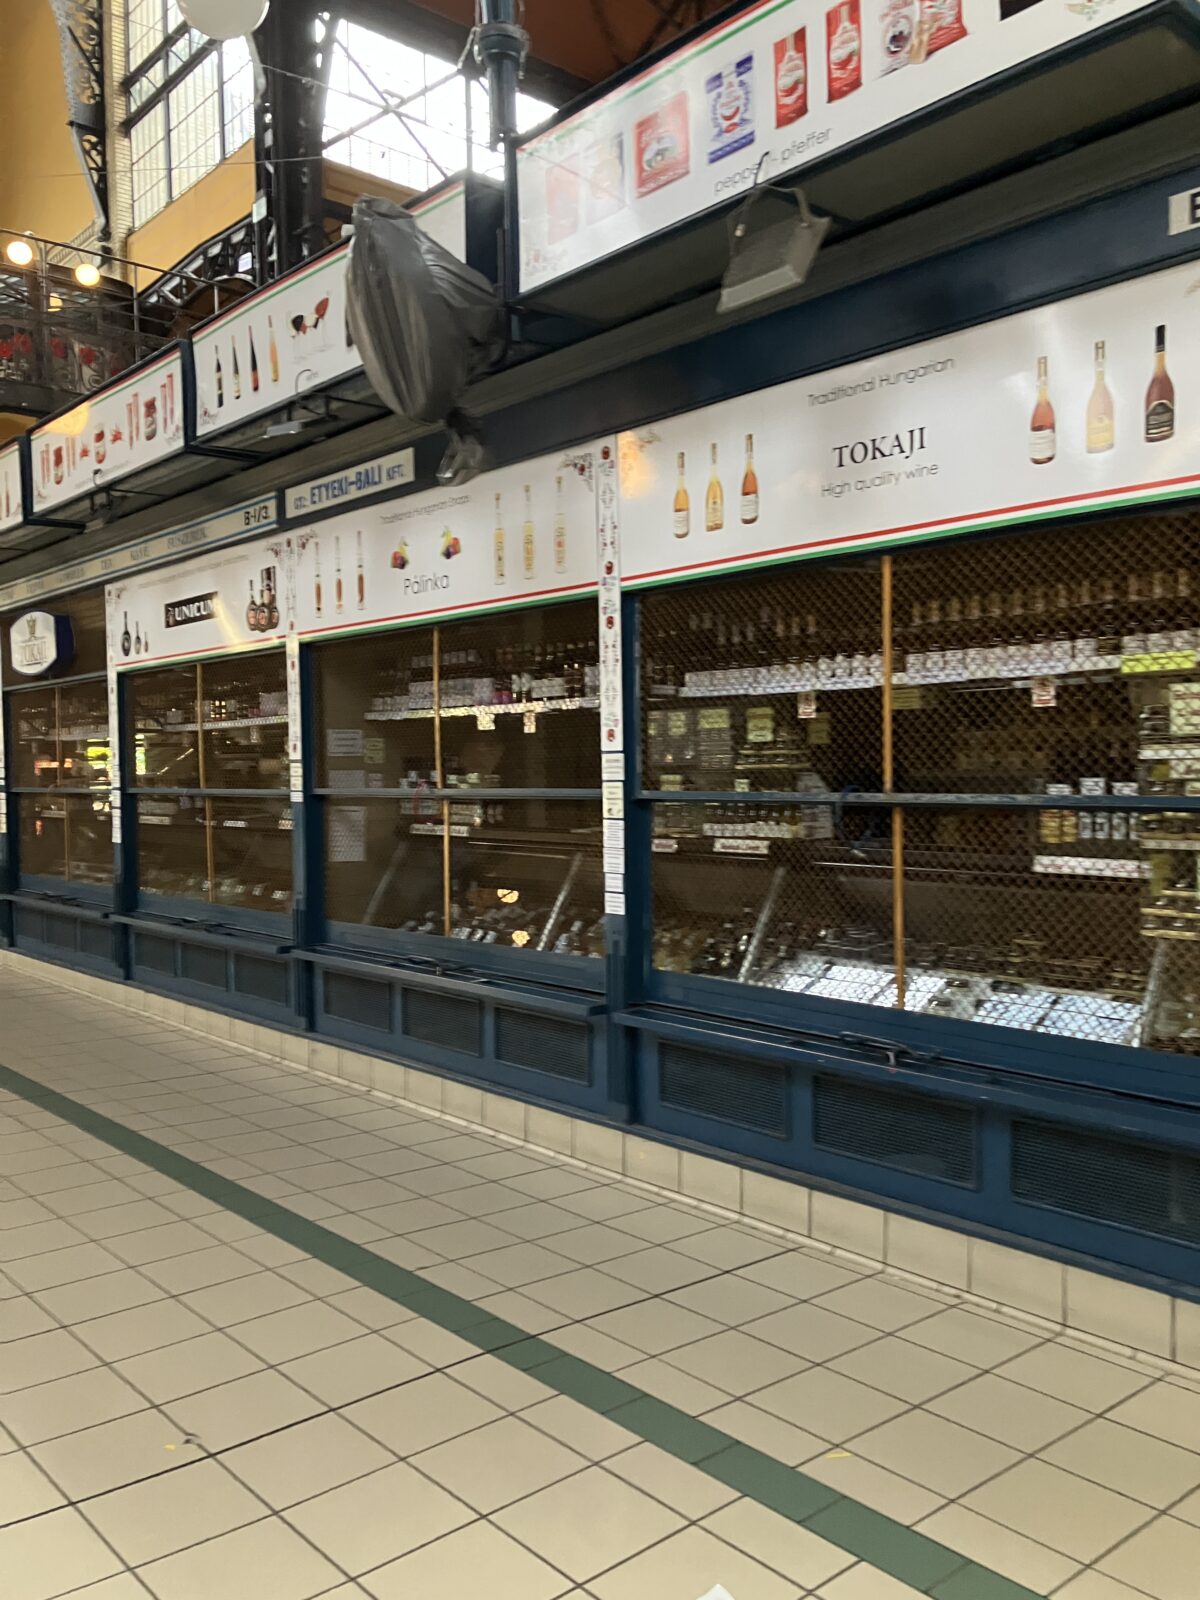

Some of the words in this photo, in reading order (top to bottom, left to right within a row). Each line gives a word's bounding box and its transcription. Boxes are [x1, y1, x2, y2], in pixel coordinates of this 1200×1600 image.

[781, 128, 833, 164] pfeffer
[807, 375, 876, 407] Traditional
[879, 358, 955, 385] Hungarian
[832, 426, 927, 468] TOKAJI
[821, 481, 851, 498] High
[854, 470, 902, 493] quality
[904, 463, 939, 480] wine
